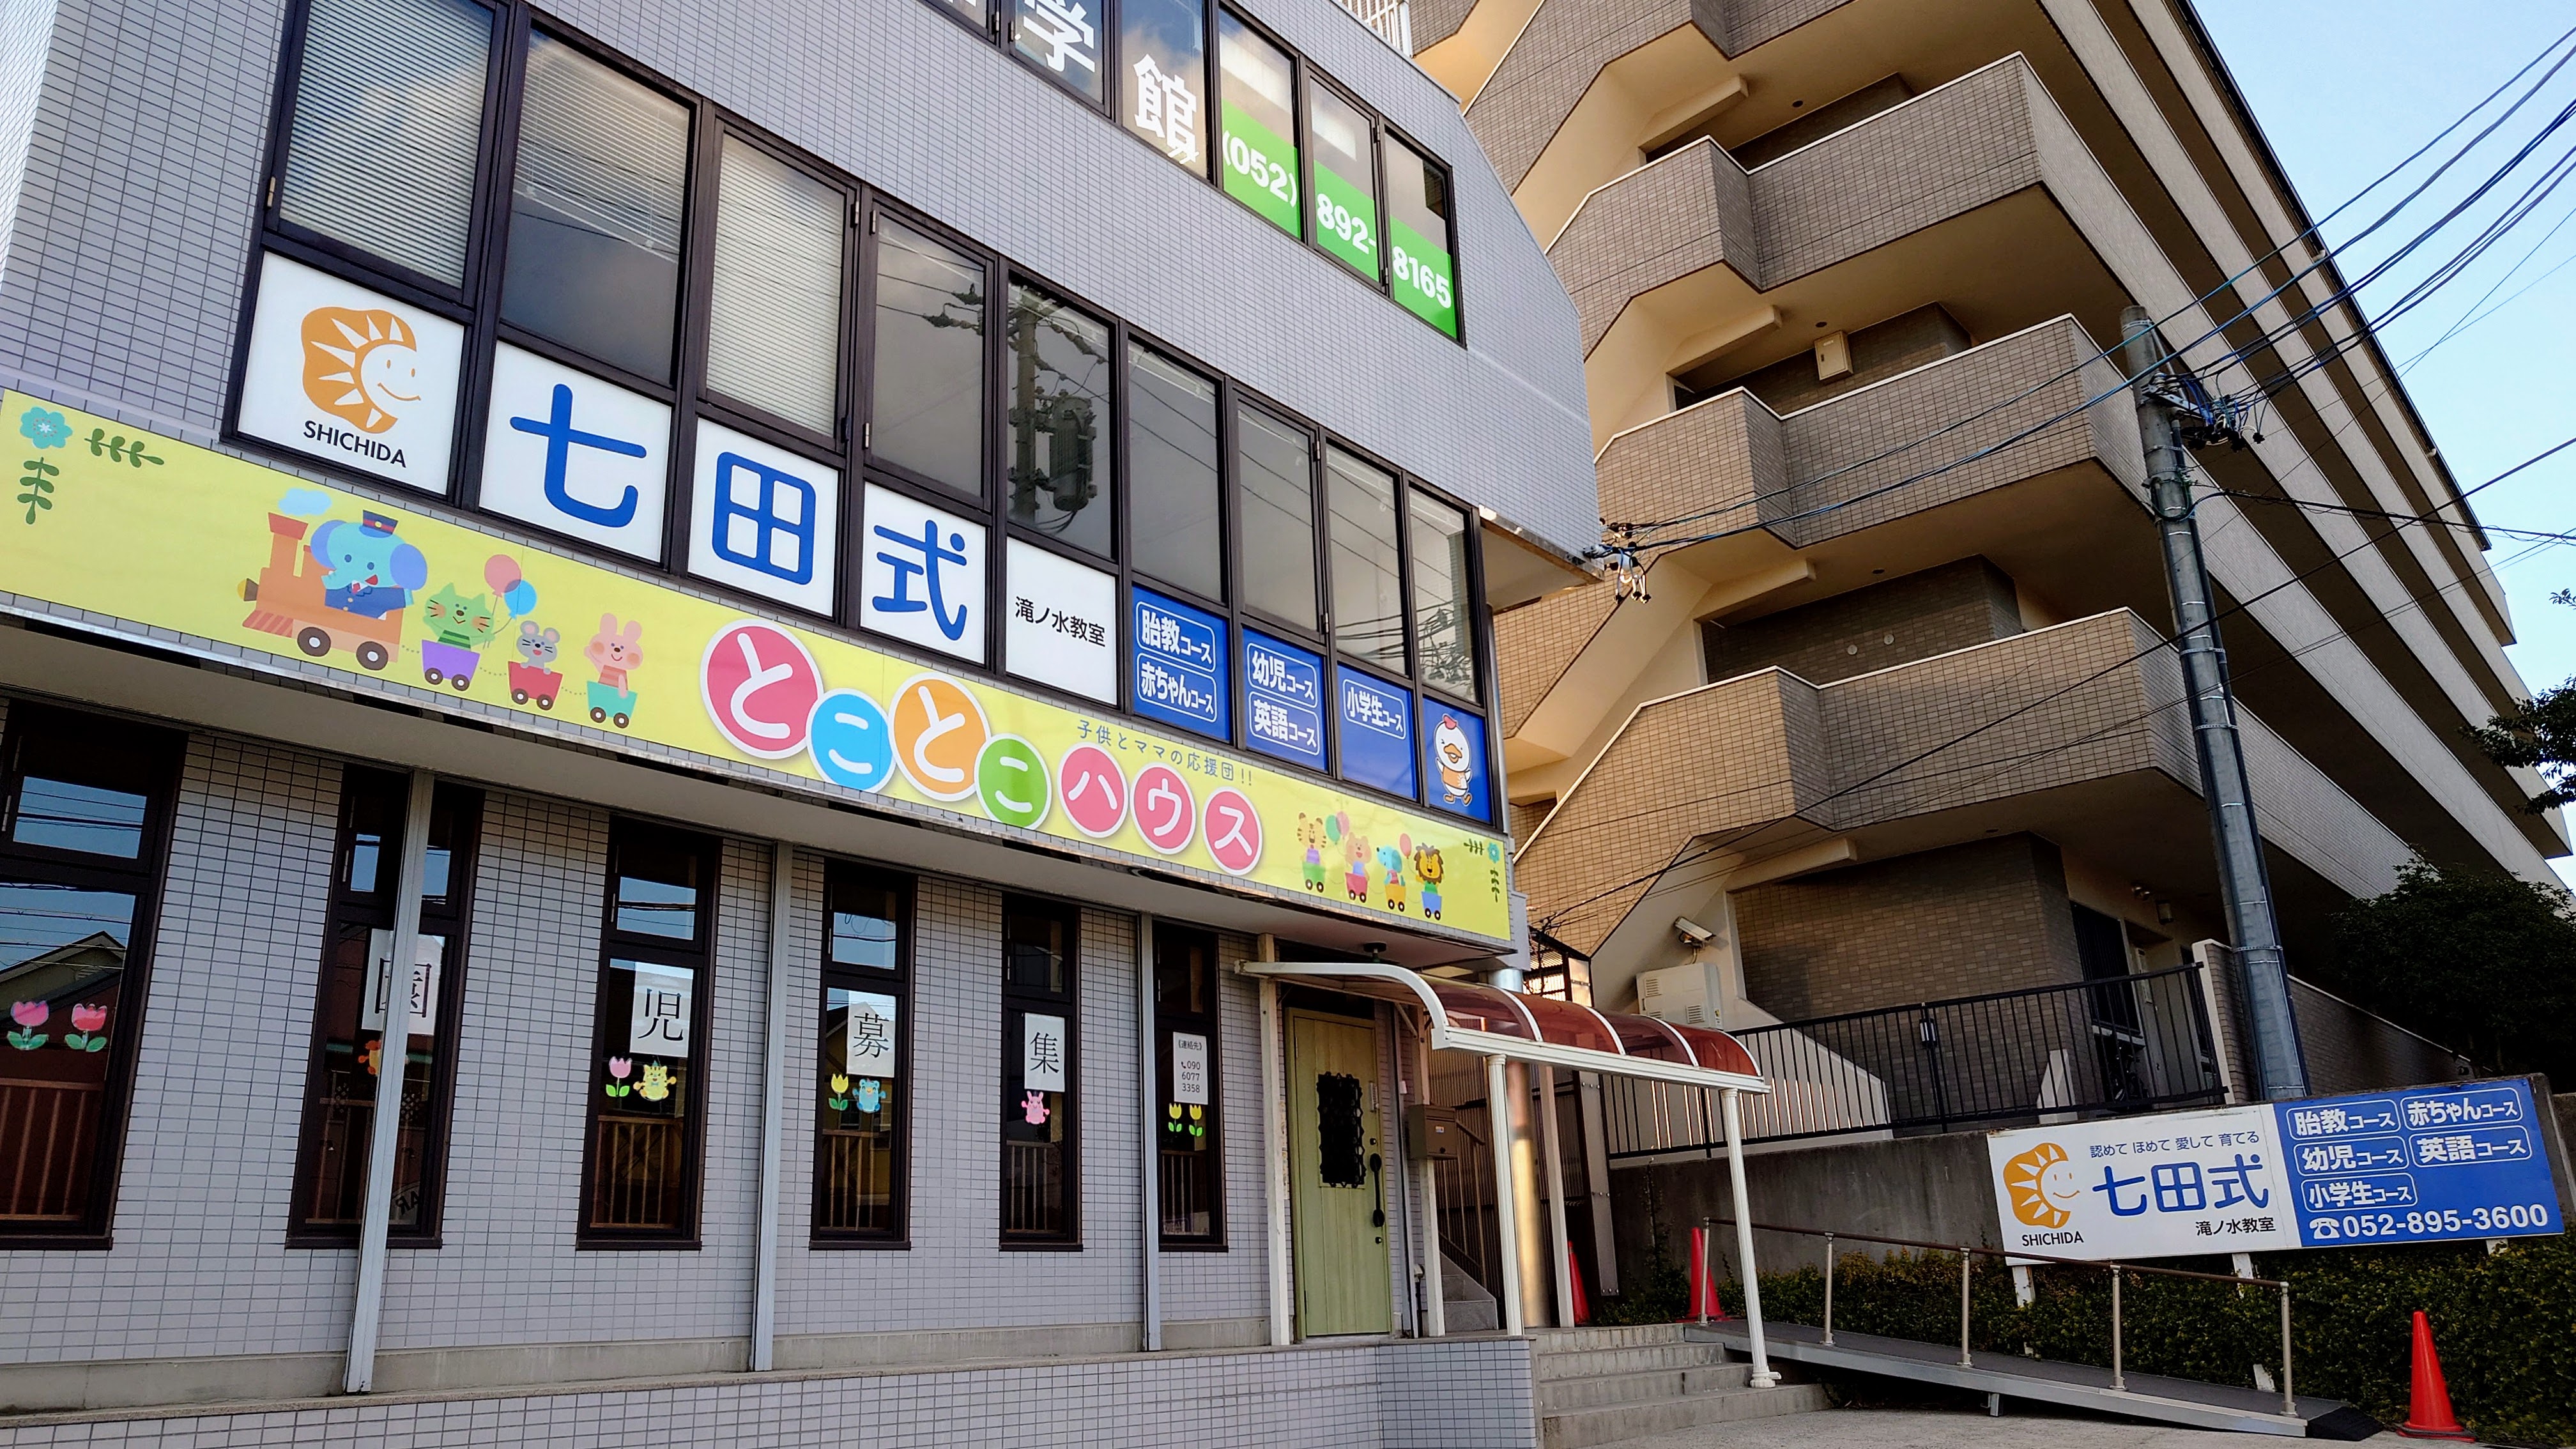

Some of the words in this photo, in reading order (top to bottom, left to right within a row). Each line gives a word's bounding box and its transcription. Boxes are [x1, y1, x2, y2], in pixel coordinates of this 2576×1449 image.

[1222, 130, 1298, 208] (052)
[1393, 246, 1452, 309] 8165
[303, 420, 407, 468] SHICHIDA
[1015, 595, 1107, 648] 滝ノ水教室
[1141, 612, 1213, 664] 胎教コース
[1140, 661, 1214, 714] 赤ちゃんコース
[1251, 651, 1315, 701] 幼児コース
[1254, 699, 1317, 748] 英語コース
[1346, 686, 1404, 733] 小学生コース
[730, 631, 1253, 857] とことこハウス
[1181, 1071, 1200, 1081] 6077
[1186, 1061, 1201, 1070] 090
[1182, 1083, 1200, 1093] 3358
[2296, 1108, 2396, 1137] 胎教コース
[2407, 1097, 2518, 1127] 赤ちゃんコース
[2301, 1144, 2404, 1172] 幼児コース
[2417, 1135, 2527, 1163] 英語コース
[2092, 1153, 2269, 1216] 七田式
[2308, 1181, 2413, 1209] 小学生コース
[2195, 1216, 2276, 1237] 滝ノ水教室
[2342, 1204, 2549, 1238] 052-895-3600
[2021, 1230, 2085, 1247] SHICHIDA
